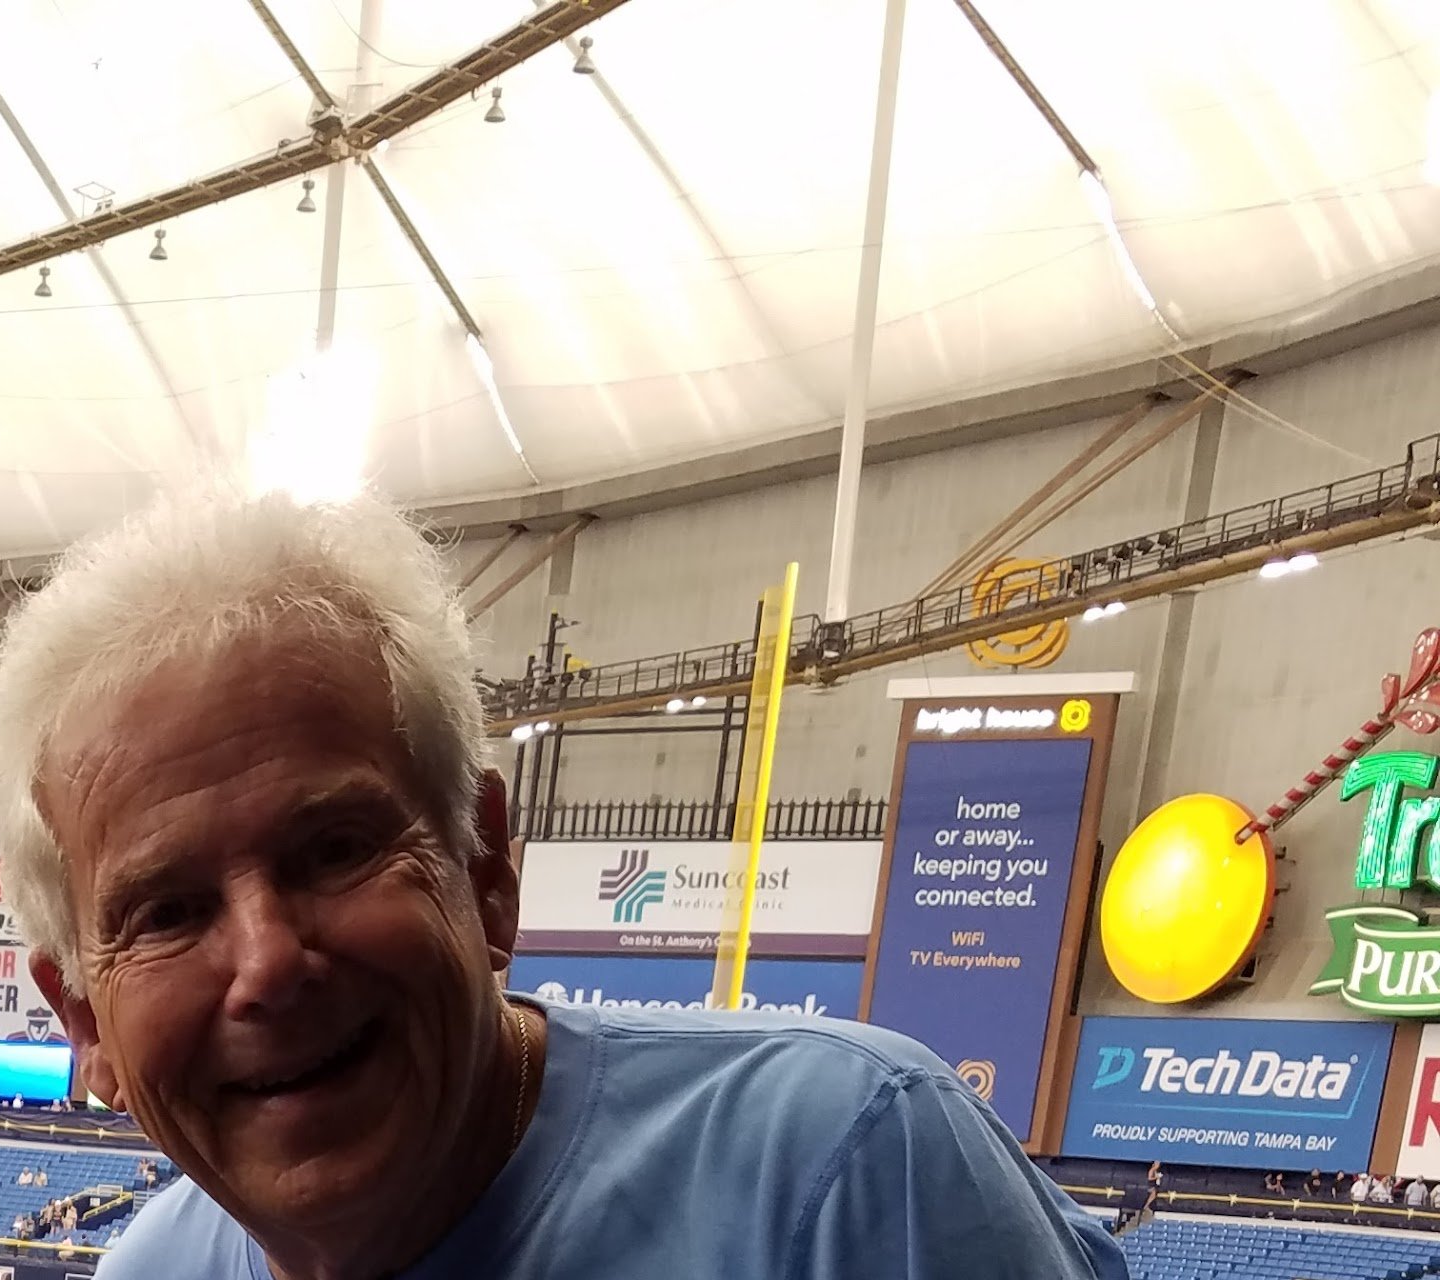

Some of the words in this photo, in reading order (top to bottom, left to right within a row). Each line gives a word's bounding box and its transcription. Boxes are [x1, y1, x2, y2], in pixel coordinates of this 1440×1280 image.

[956, 796, 1021, 821] home
[935, 829, 959, 846] or
[962, 829, 1035, 851] away...
[913, 852, 1002, 882] keeping
[1005, 858, 1048, 882] you
[914, 883, 1037, 908] connected.
[620, 934, 635, 946] On
[635, 934, 652, 946] the
[910, 951, 931, 967] TV
[933, 952, 1021, 971] Everywhere
[1092, 1123, 1157, 1142] PROUDLY
[1158, 1125, 1249, 1147] SUPPORTING
[1254, 1132, 1301, 1150] TAMPA
[1305, 1136, 1337, 1152] BAY
